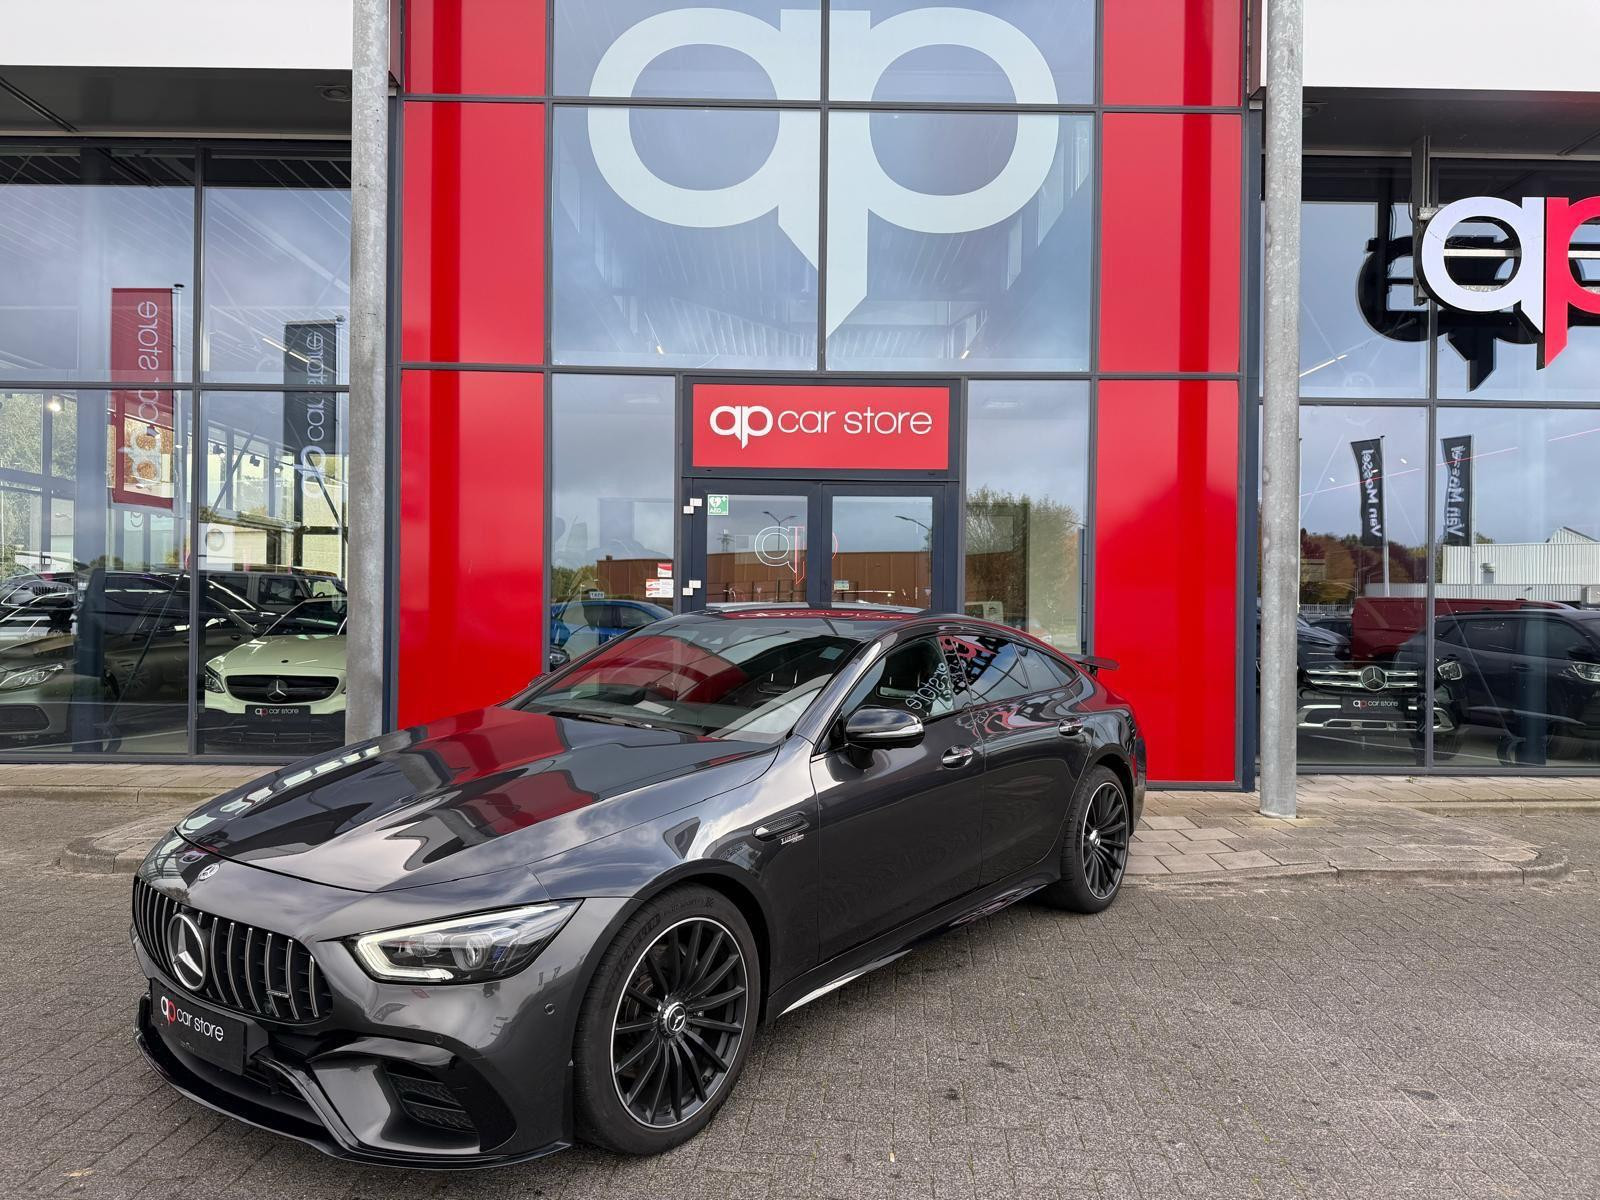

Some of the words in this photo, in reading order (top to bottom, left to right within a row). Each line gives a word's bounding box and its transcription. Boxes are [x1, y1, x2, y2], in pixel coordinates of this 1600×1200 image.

[709, 405, 774, 450] ap
[777, 410, 837, 434] car
[843, 406, 933, 435] store
[160, 995, 176, 1024] ap
[177, 1008, 193, 1027] car
[194, 1016, 224, 1042] store
